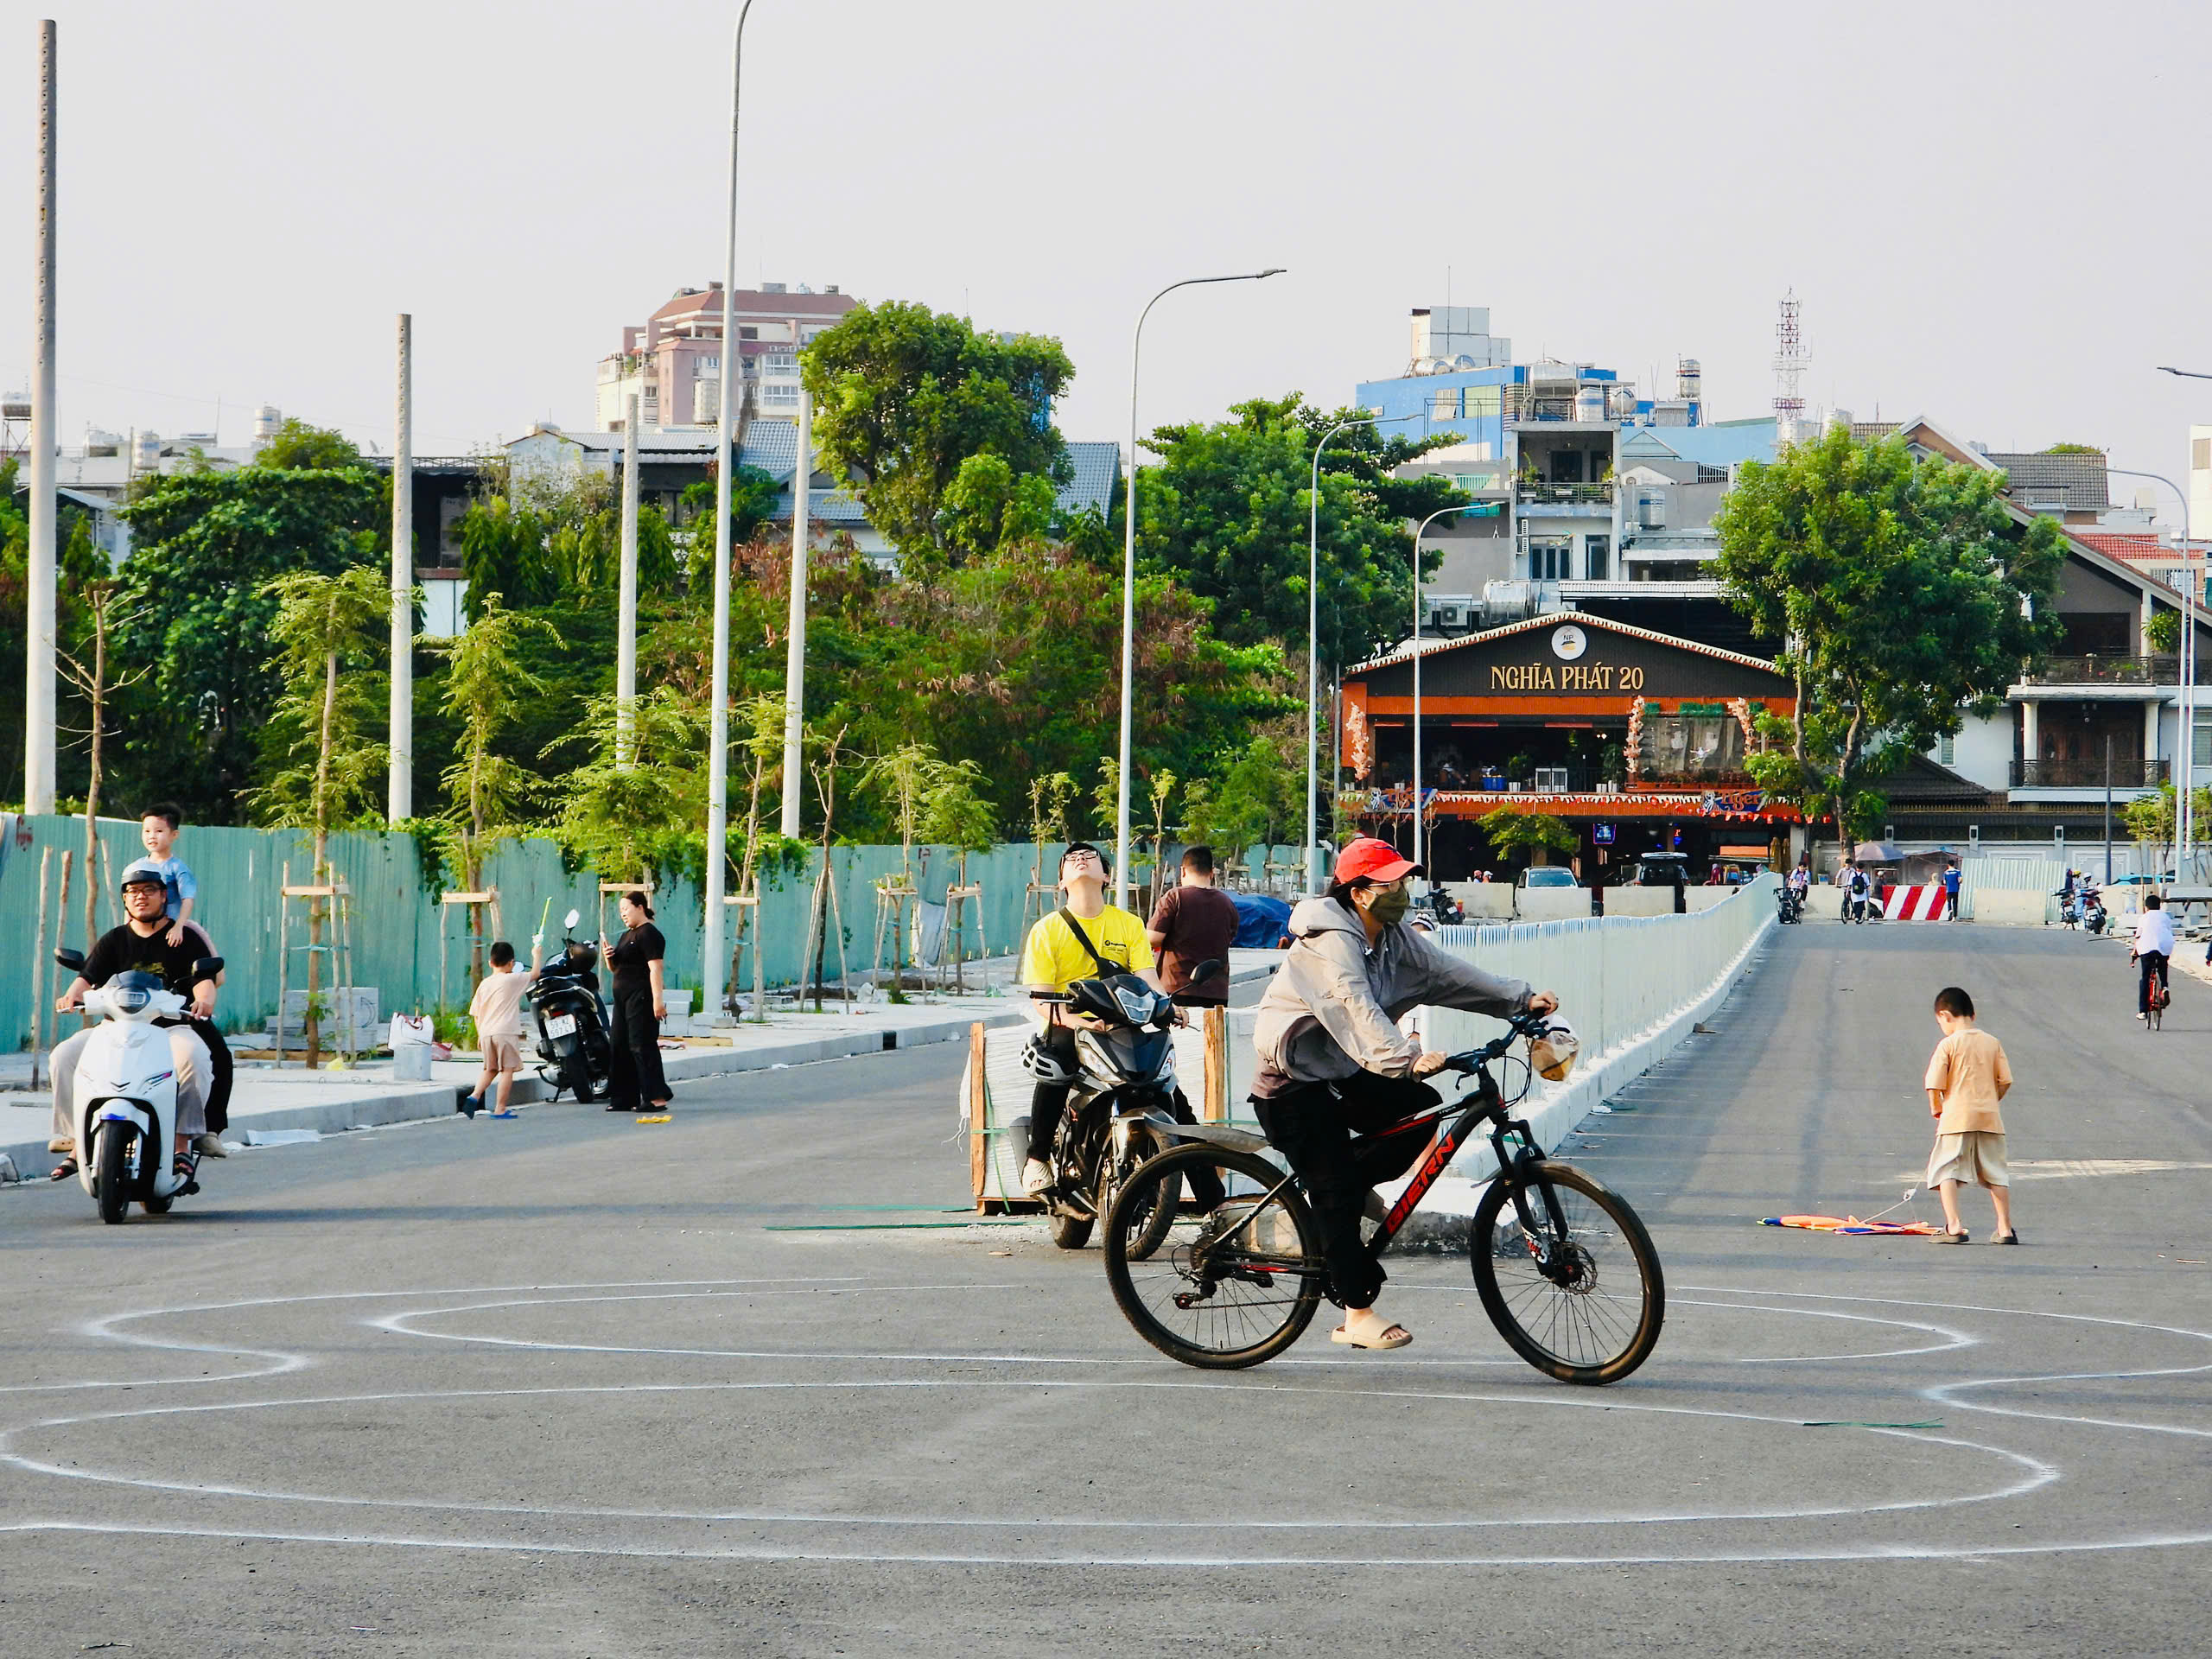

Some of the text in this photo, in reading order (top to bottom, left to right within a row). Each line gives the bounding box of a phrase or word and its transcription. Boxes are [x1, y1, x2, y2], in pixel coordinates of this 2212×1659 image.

[1491, 661, 1644, 690] NGHĨA PHÁT 20
[1718, 789, 1760, 810] Tiger
